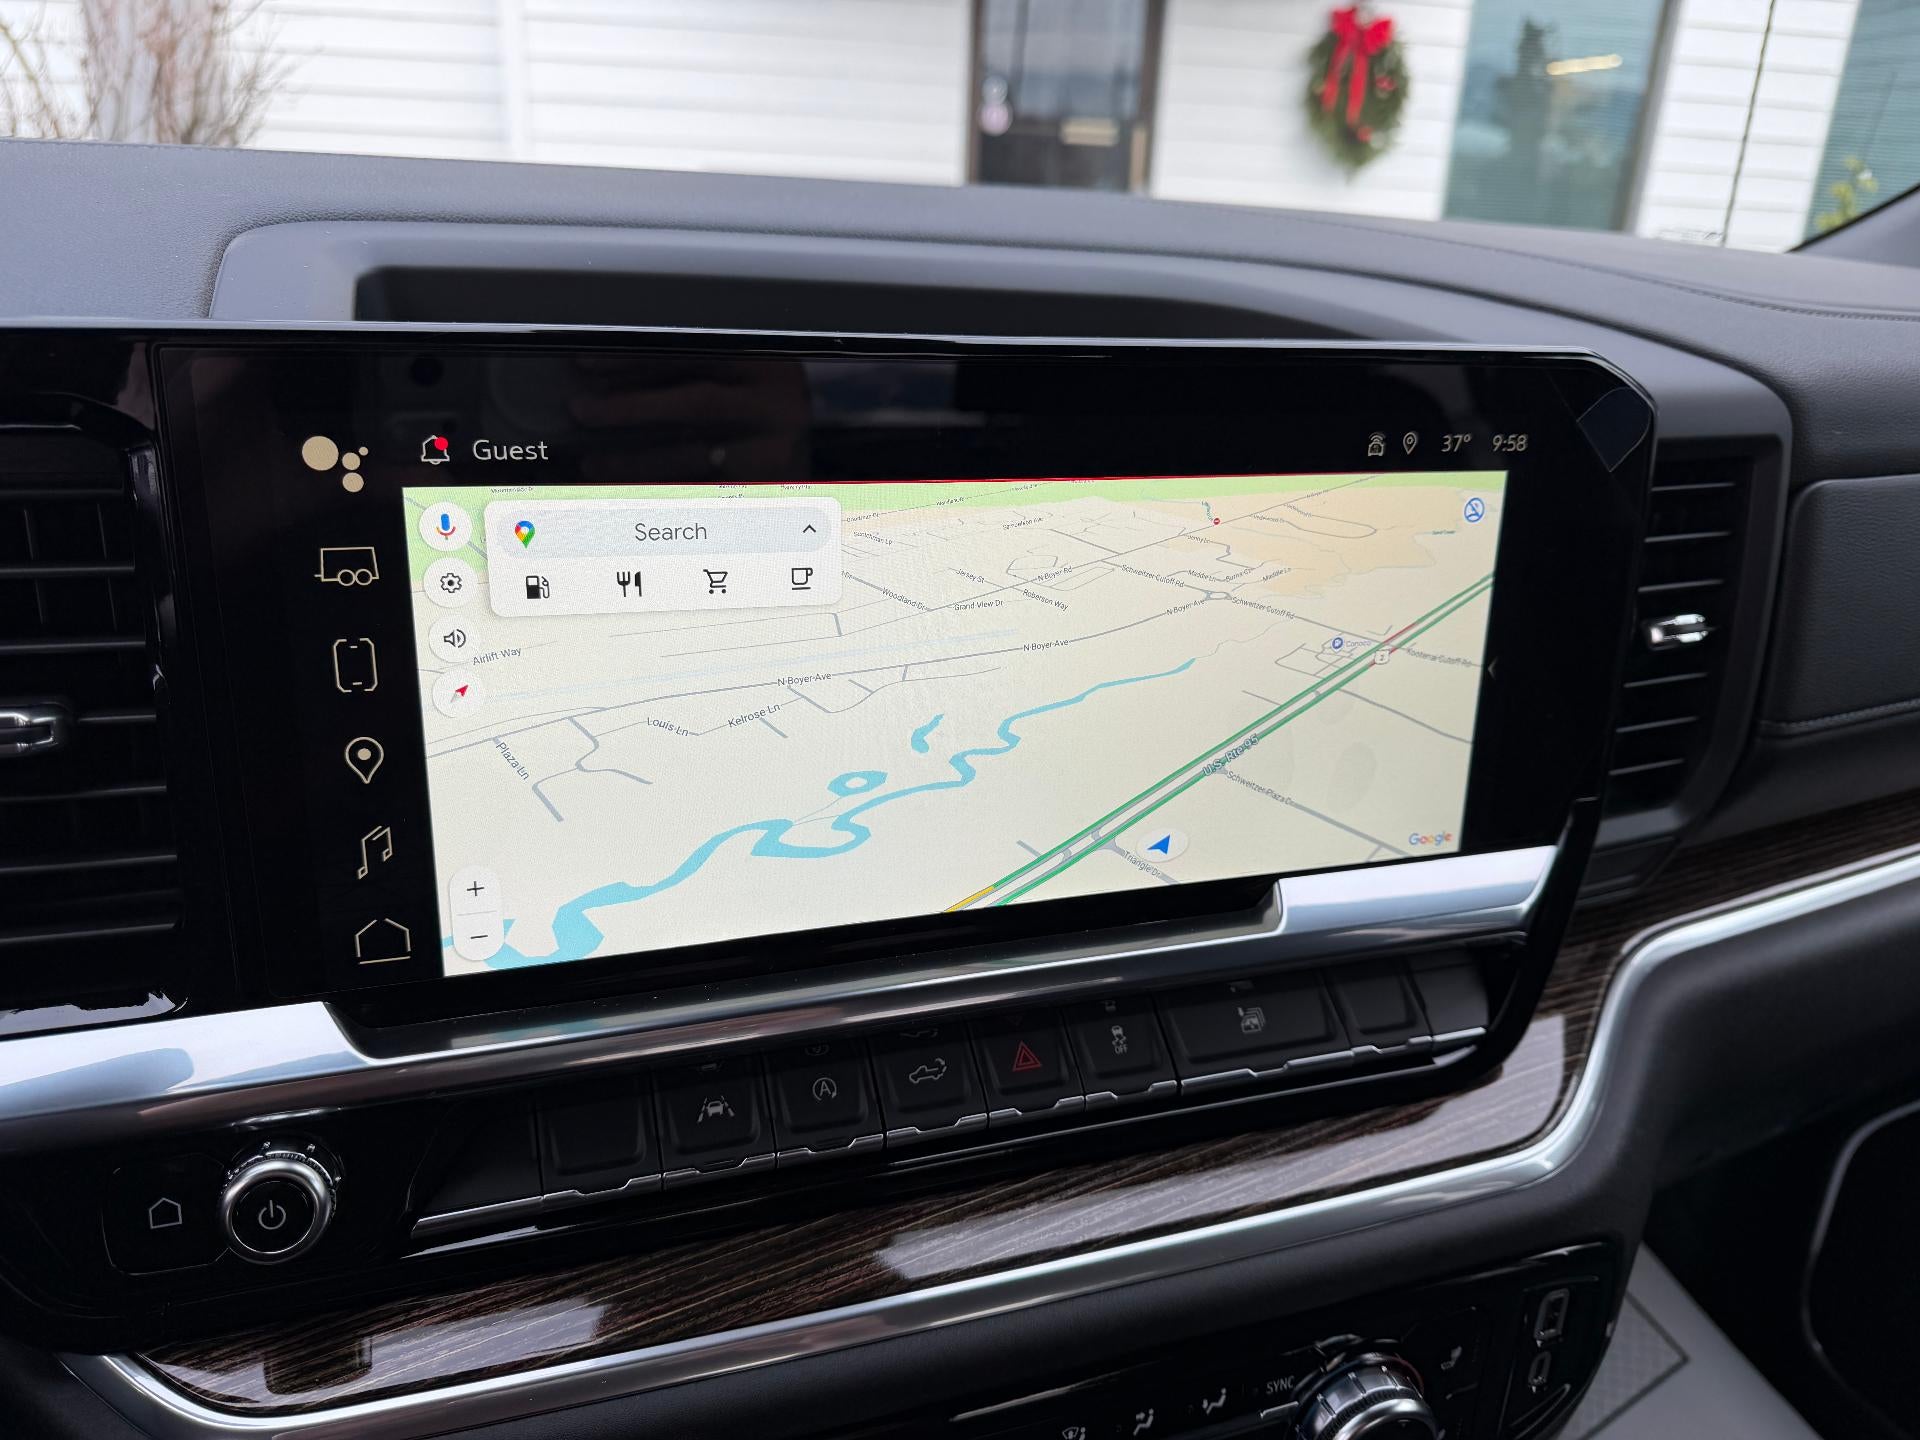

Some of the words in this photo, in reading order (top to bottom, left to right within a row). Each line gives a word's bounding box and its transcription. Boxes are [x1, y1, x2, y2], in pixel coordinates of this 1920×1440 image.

[472, 438, 549, 461] Guest
[1492, 434, 1528, 452] 9:58
[634, 521, 708, 542] Search
[956, 567, 978, 583] Jersey
[977, 575, 985, 584] St
[1037, 574, 1044, 582] N
[1044, 568, 1063, 582] Boyer
[1063, 565, 1073, 574] Rd
[1121, 564, 1155, 579] Schweitzer
[1155, 574, 1176, 585] Cutoff
[1175, 580, 1185, 588] Rd
[882, 587, 917, 607] Woodland
[916, 601, 925, 611] Dr
[954, 600, 975, 611] Grand
[976, 599, 993, 609] View
[993, 599, 1004, 608] Dr
[1022, 588, 1051, 606] Roberson
[1051, 598, 1069, 612] Way
[1166, 608, 1173, 616] N
[1173, 602, 1192, 613] Boyer
[1193, 599, 1205, 607] Ave
[1231, 596, 1266, 611] Schweitzer
[1266, 605, 1287, 617] Cutoff
[1286, 611, 1295, 620] Rd
[1023, 644, 1030, 652] N
[1030, 640, 1052, 652] Boyer
[1053, 637, 1069, 647] Ave
[472, 651, 499, 666] Airlift
[500, 646, 522, 661] Way
[777, 677, 786, 688] N
[786, 674, 811, 688] Boyer
[812, 671, 832, 683] Ave
[727, 706, 766, 728] Kelrose
[766, 703, 781, 715] Ln
[646, 716, 675, 734] Louis
[674, 726, 690, 738] Ln
[496, 740, 520, 771] Plaza
[517, 766, 530, 781] Ln
[1227, 770, 1265, 793] Schweitzer
[1265, 788, 1285, 803] Plaza
[1408, 829, 1454, 847] Google
[1124, 849, 1151, 873] Triangle
[1151, 867, 1162, 879] Dr
[1266, 1374, 1295, 1395] SYNC
